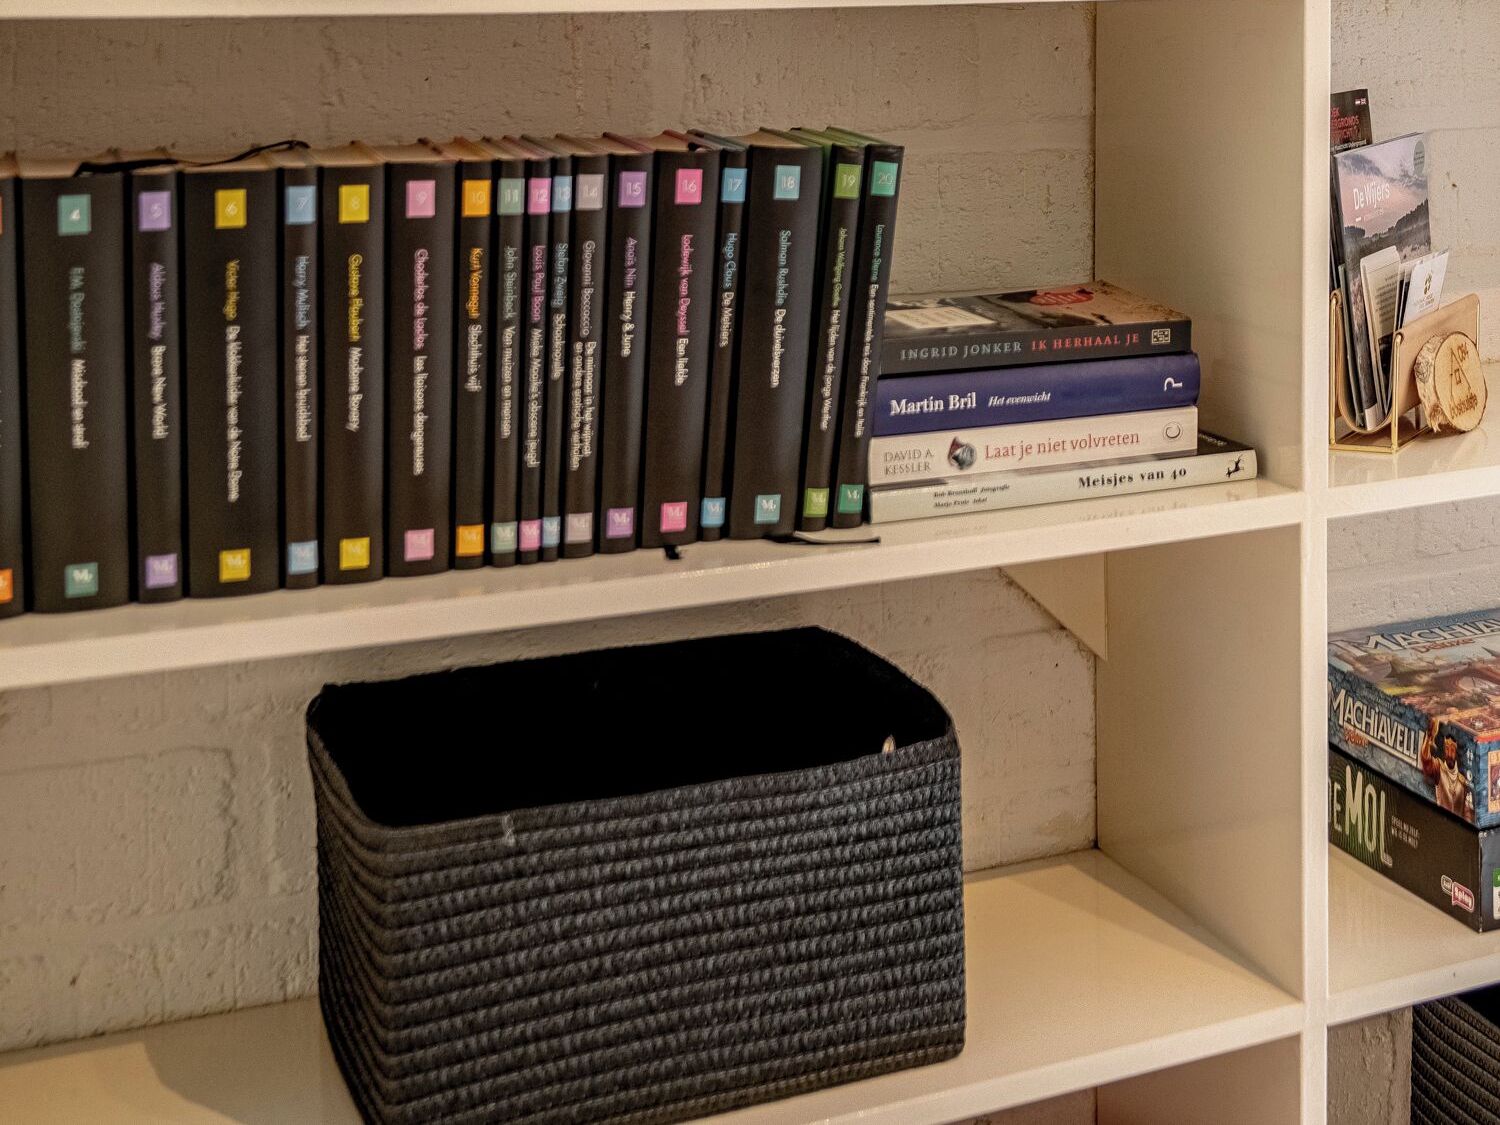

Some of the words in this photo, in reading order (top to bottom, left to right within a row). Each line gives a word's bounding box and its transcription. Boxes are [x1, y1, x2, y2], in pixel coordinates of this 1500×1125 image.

[682, 180, 697, 193] 16
[728, 179, 742, 192] 17
[781, 177, 795, 189] 18
[842, 175, 855, 187] 19
[878, 173, 892, 184] 20
[1353, 188, 1364, 210] De
[1364, 181, 1390, 208] Wijers
[721, 232, 738, 259] Hugo
[723, 261, 737, 289] Claus
[722, 292, 734, 307] De
[719, 308, 733, 347] Metsiers
[901, 346, 958, 361] INGRID
[963, 341, 1022, 358] JONKER
[1032, 339, 1047, 351] IK
[1053, 333, 1121, 348] HERHAAL
[890, 395, 944, 416] Martin
[948, 392, 977, 410] Bril
[988, 396, 1005, 407] Het
[1005, 392, 1051, 406] evenwicht
[985, 444, 1016, 460] Laat
[1037, 437, 1067, 454] niet
[1070, 430, 1140, 452] volvreten
[885, 463, 932, 475] KESSLER
[1078, 472, 1134, 490] Meisjes
[1138, 471, 1165, 482] van
[1171, 468, 1187, 480] 40
